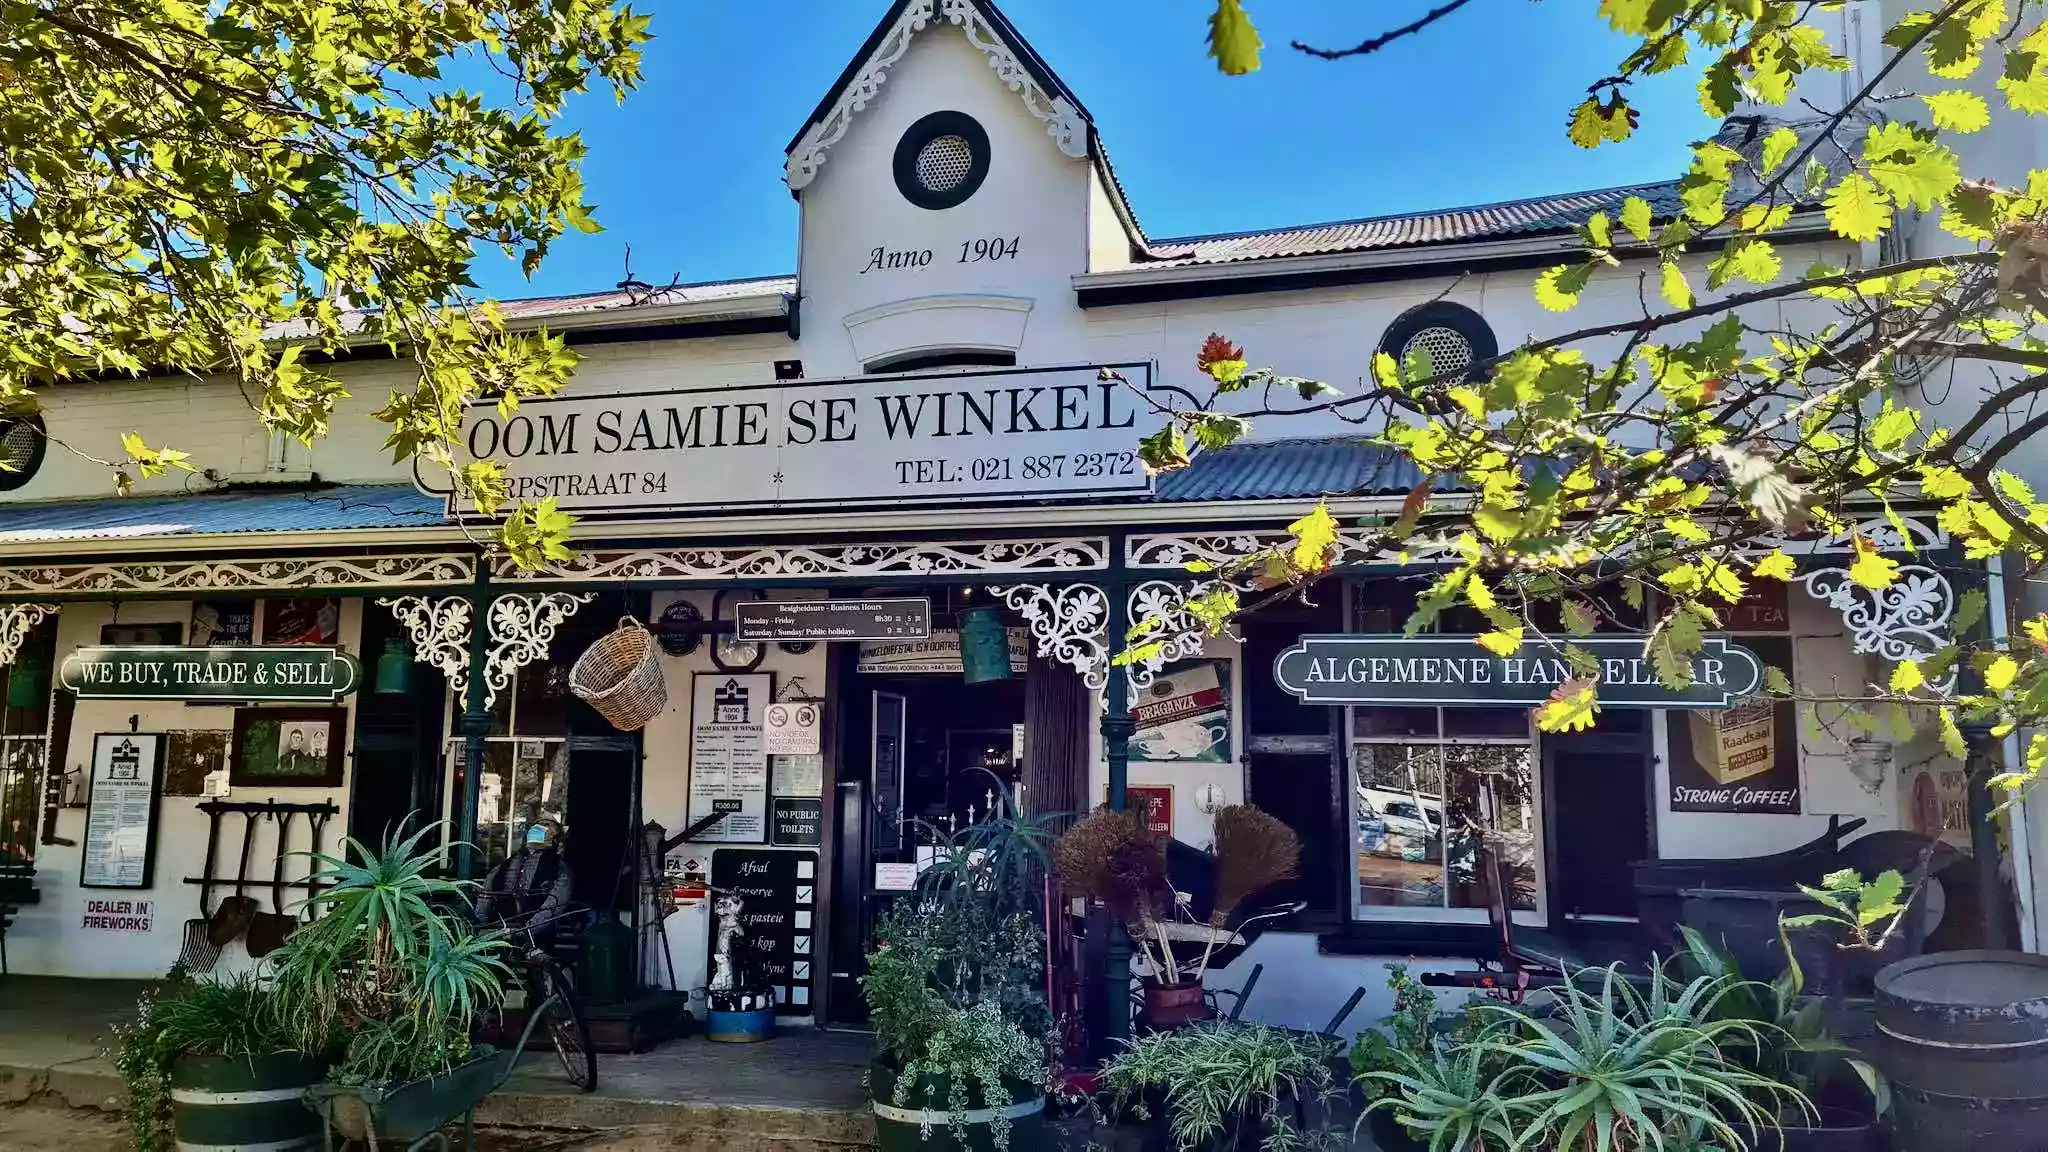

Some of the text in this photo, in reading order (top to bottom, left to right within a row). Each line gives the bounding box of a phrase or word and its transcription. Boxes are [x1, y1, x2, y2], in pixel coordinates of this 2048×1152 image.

[860, 235, 1021, 275] Anno 1904
[468, 382, 1136, 460] OOM SAMIE SE WINKEL
[895, 451, 1135, 484] TEL: 021 887 2372
[463, 471, 668, 501] RPSTRAAT 84
[830, 603, 860, 611] Business
[861, 603, 883, 611] Hours
[743, 617, 770, 626] Monday
[774, 617, 796, 626] Friday
[743, 628, 773, 638] Saturday
[806, 627, 827, 636] Public
[827, 627, 856, 637] holidays
[79, 661, 334, 688] WE BUY, TRADE & SELL
[1304, 657, 1726, 686] ALGEMENE HANELR
[1137, 695, 1198, 721] BRAGANZA
[1722, 727, 1770, 750] Raadsaal
[1673, 785, 1797, 806] STRONG COFFEE!
[776, 810, 820, 819] NO PUBLIC
[780, 825, 814, 834] TOILETS
[737, 860, 771, 877] Afval
[87, 900, 148, 915] DEALER IN
[82, 915, 149, 931] FIREWORKS
[749, 911, 784, 926] pasteie
[757, 935, 776, 952] kop
